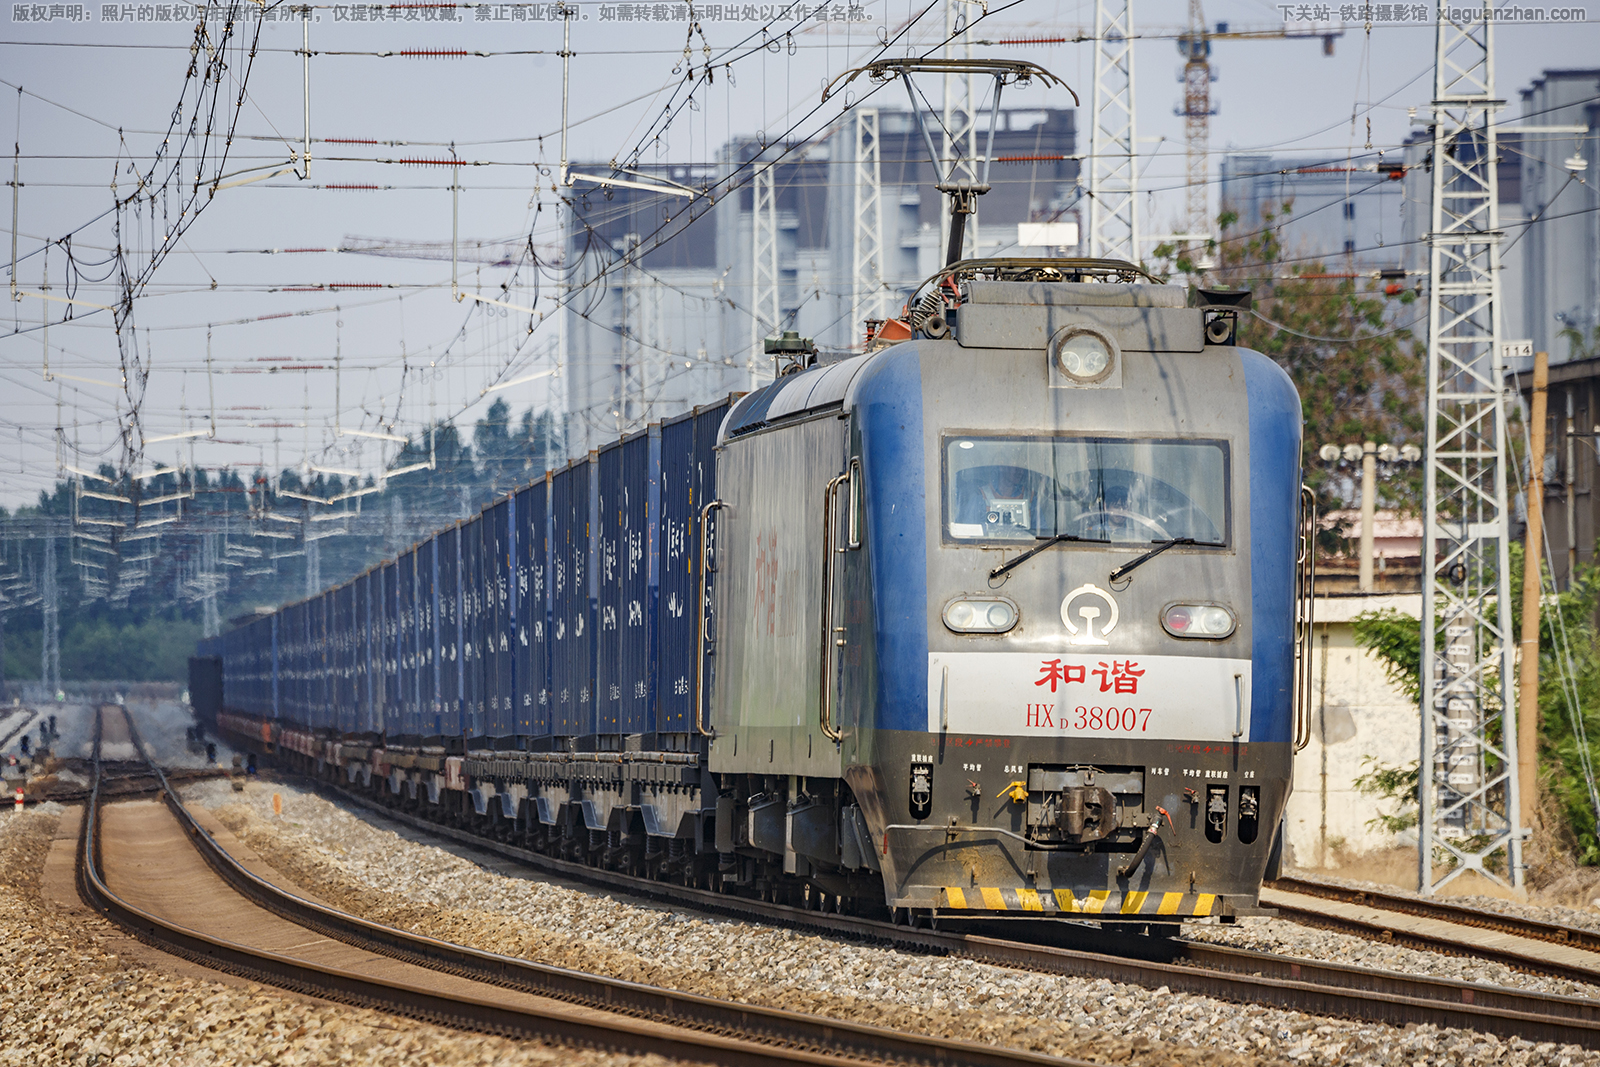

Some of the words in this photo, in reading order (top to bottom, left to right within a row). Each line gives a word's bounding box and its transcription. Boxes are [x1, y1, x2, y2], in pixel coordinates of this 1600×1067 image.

[1505, 345, 1530, 357] 114
[1034, 658, 1146, 695] 和谐
[1074, 705, 1153, 732] 38007
